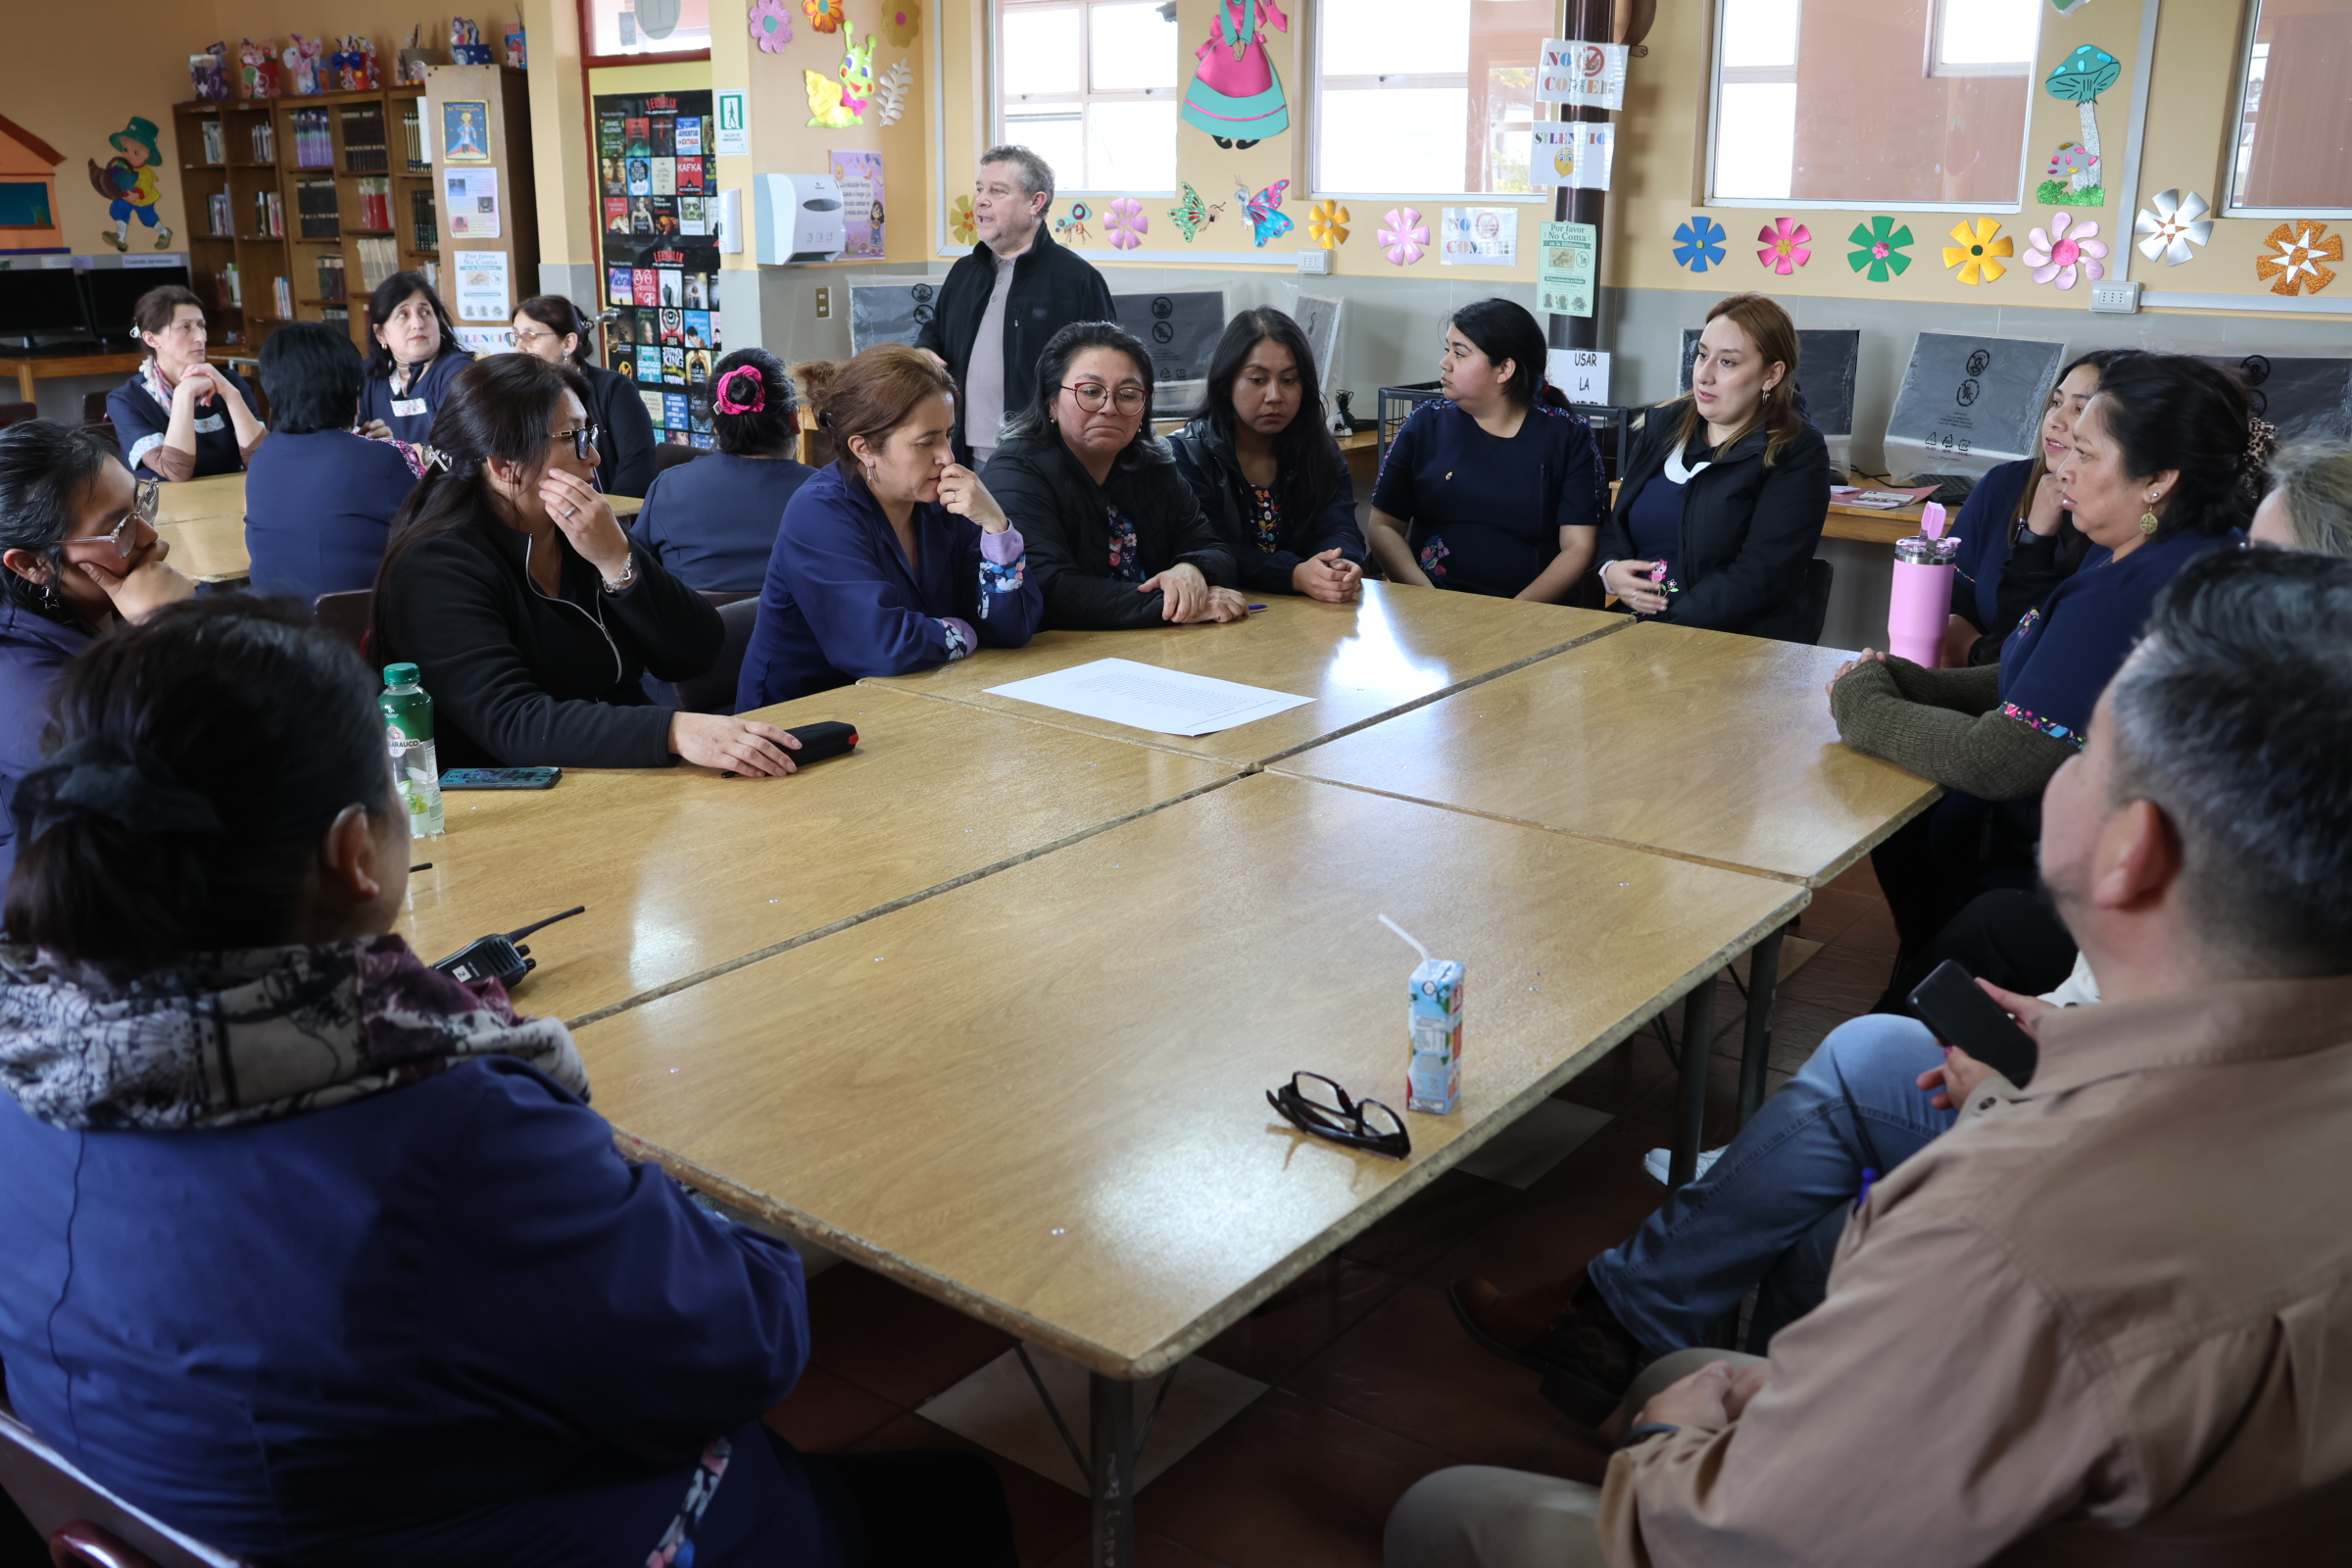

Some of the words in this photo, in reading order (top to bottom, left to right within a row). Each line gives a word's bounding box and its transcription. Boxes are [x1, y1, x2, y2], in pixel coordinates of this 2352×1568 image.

[1546, 52, 1572, 67] NO
[677, 164, 703, 172] KAFKA
[1447, 218, 1471, 231] NO
[1562, 232, 1587, 241] Coma
[666, 337, 678, 346] 1984
[662, 347, 683, 356] STEPHEN
[663, 354, 684, 368] KING
[1575, 353, 1597, 367] USAR
[1579, 376, 1590, 391] LA
